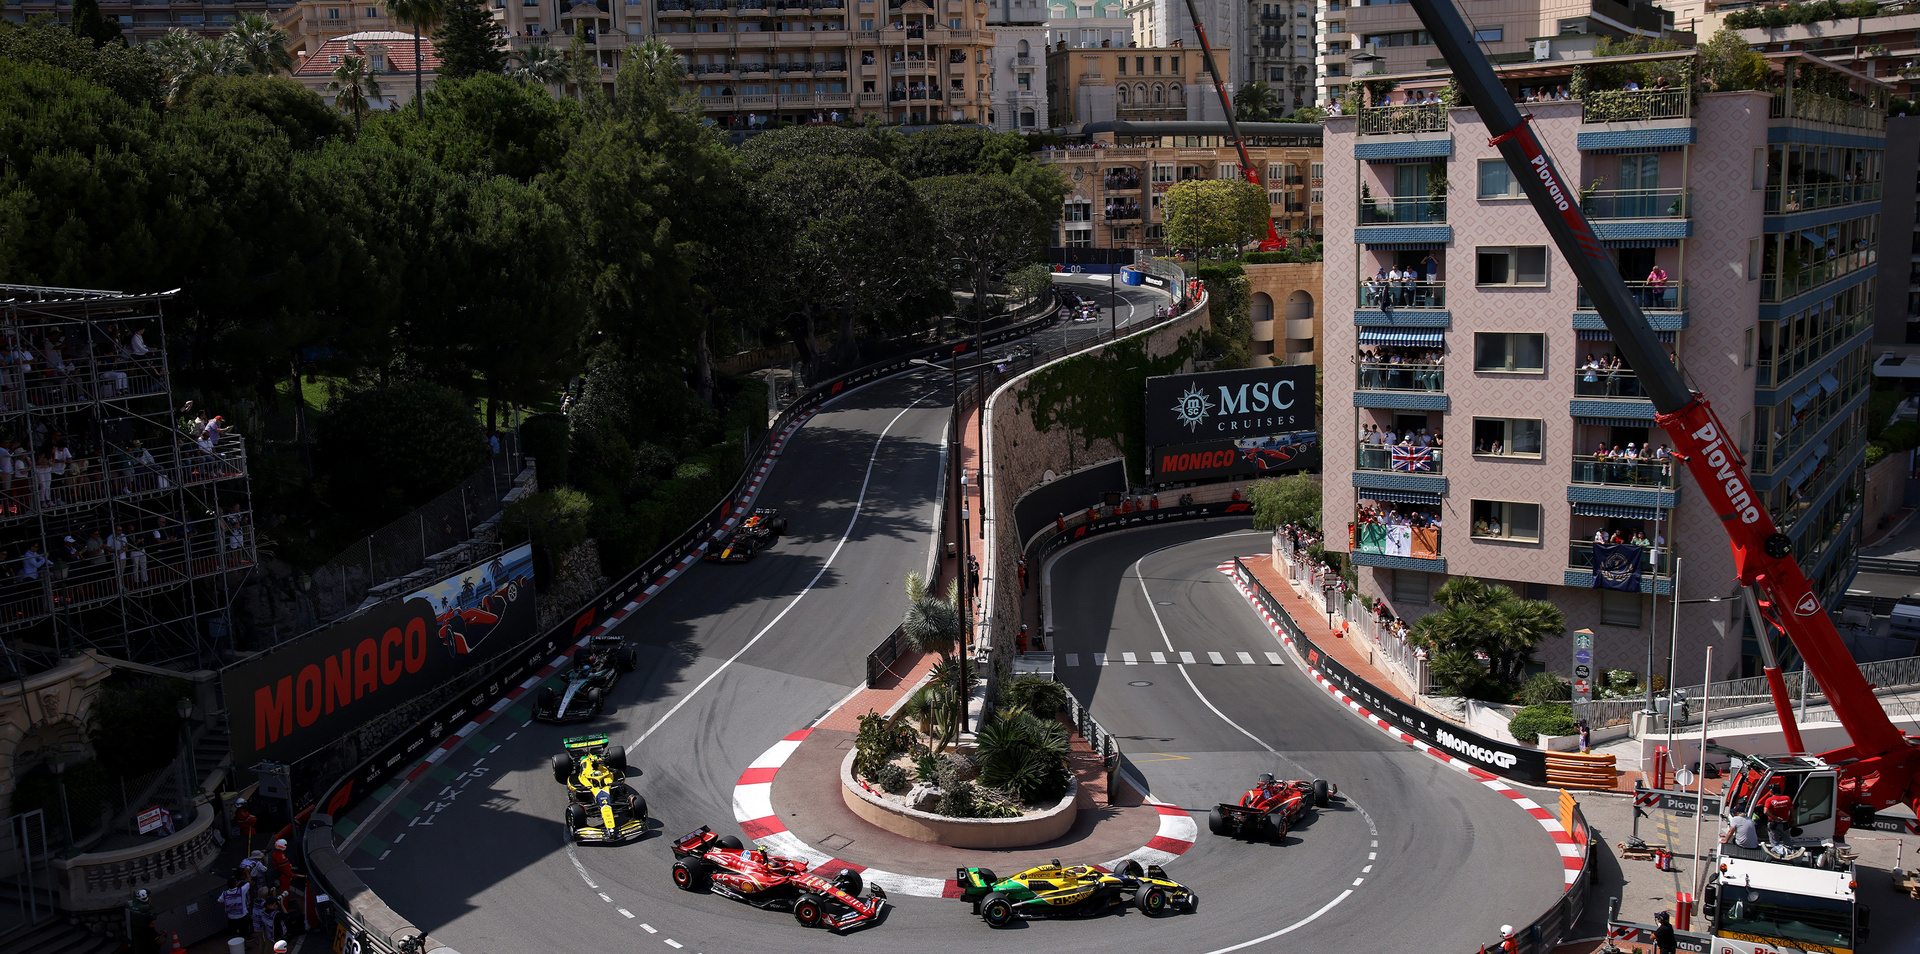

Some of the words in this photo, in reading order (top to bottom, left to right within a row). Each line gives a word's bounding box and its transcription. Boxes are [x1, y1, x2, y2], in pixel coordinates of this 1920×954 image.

[1531, 154, 1569, 211] Piovano
[1217, 380, 1295, 416] MSC
[1217, 415, 1295, 432] CRUISES
[1161, 449, 1235, 473] MONACO
[1691, 421, 1760, 525] Piovano
[254, 616, 427, 751] MONACO
[1436, 728, 1517, 769] #MonacoGP
[1668, 799, 1709, 812] Piovao
